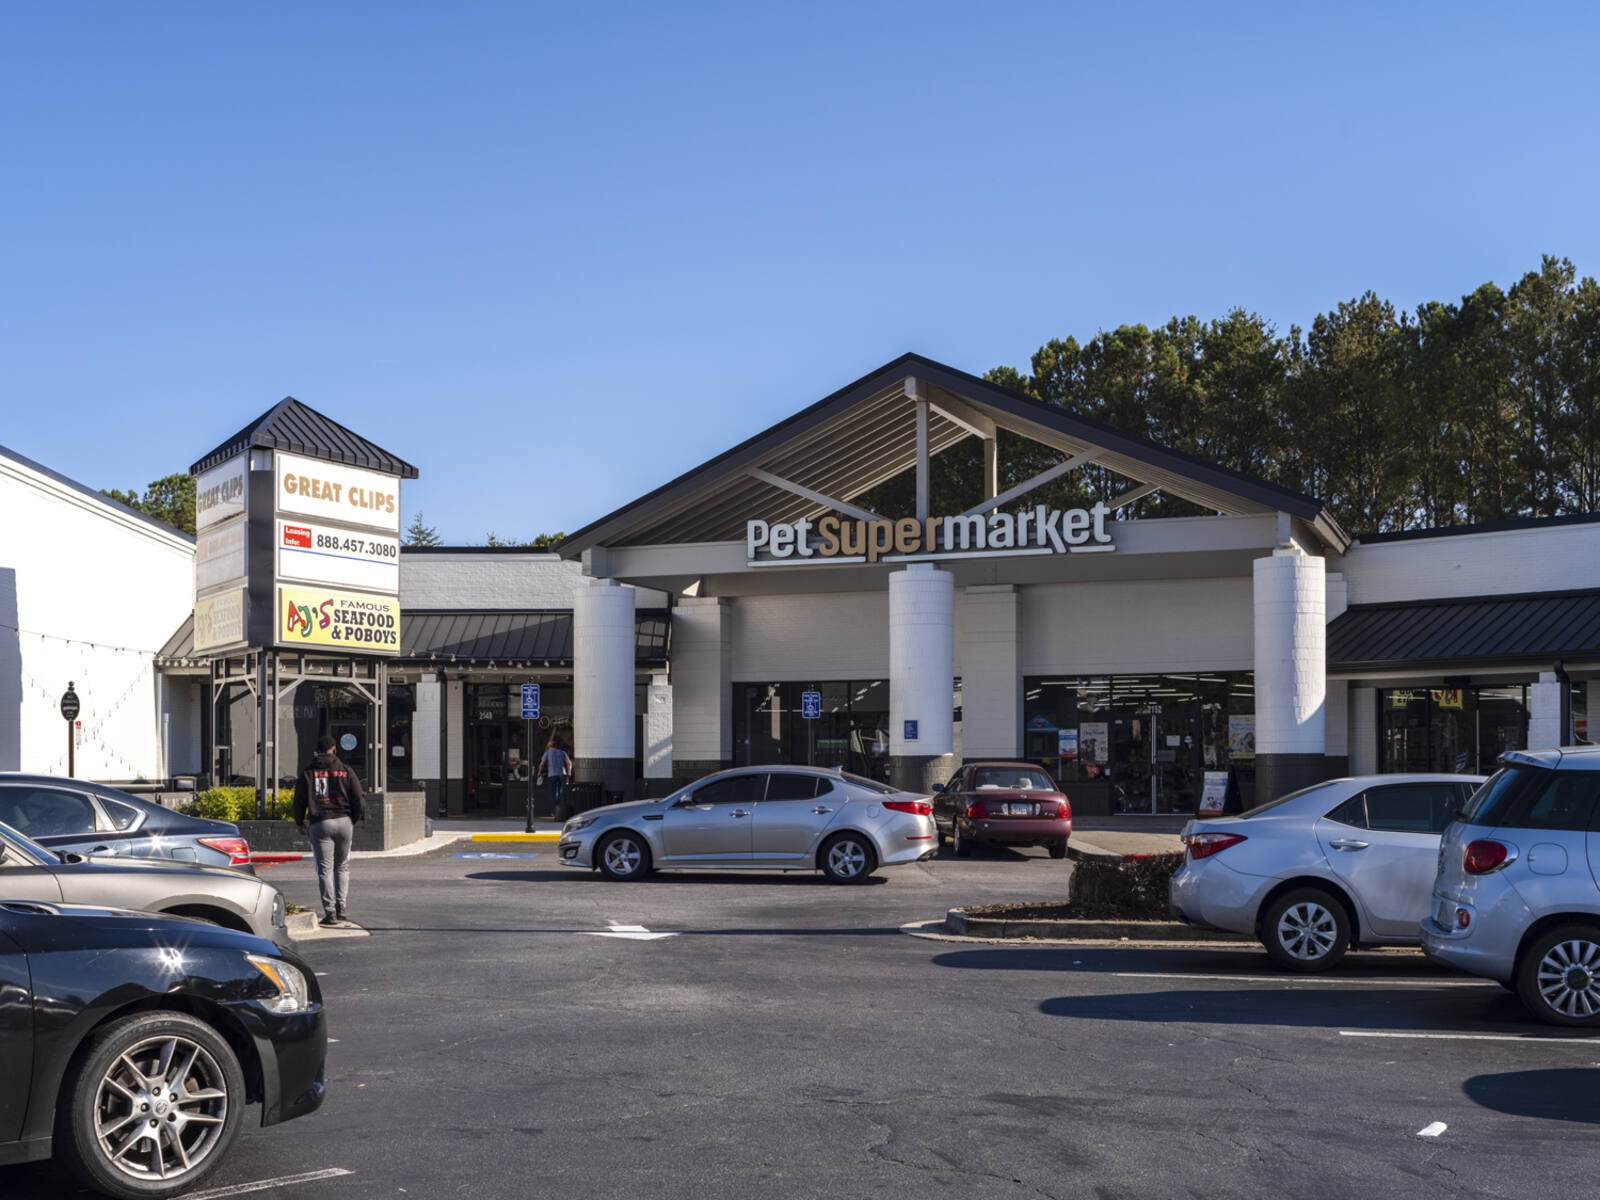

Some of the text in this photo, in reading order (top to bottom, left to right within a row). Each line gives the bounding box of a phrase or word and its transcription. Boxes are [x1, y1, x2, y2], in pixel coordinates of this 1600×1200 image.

[221, 474, 243, 504] CLIPS
[283, 472, 395, 514] GREAT CLIPS
[285, 526, 311, 539] Leasing
[316, 534, 397, 558] 888.457.3080
[340, 600, 390, 612] FAMOUS
[287, 598, 334, 638] AJ'S
[334, 608, 395, 628] SEAFOOD
[331, 625, 397, 645] & POBOYS
